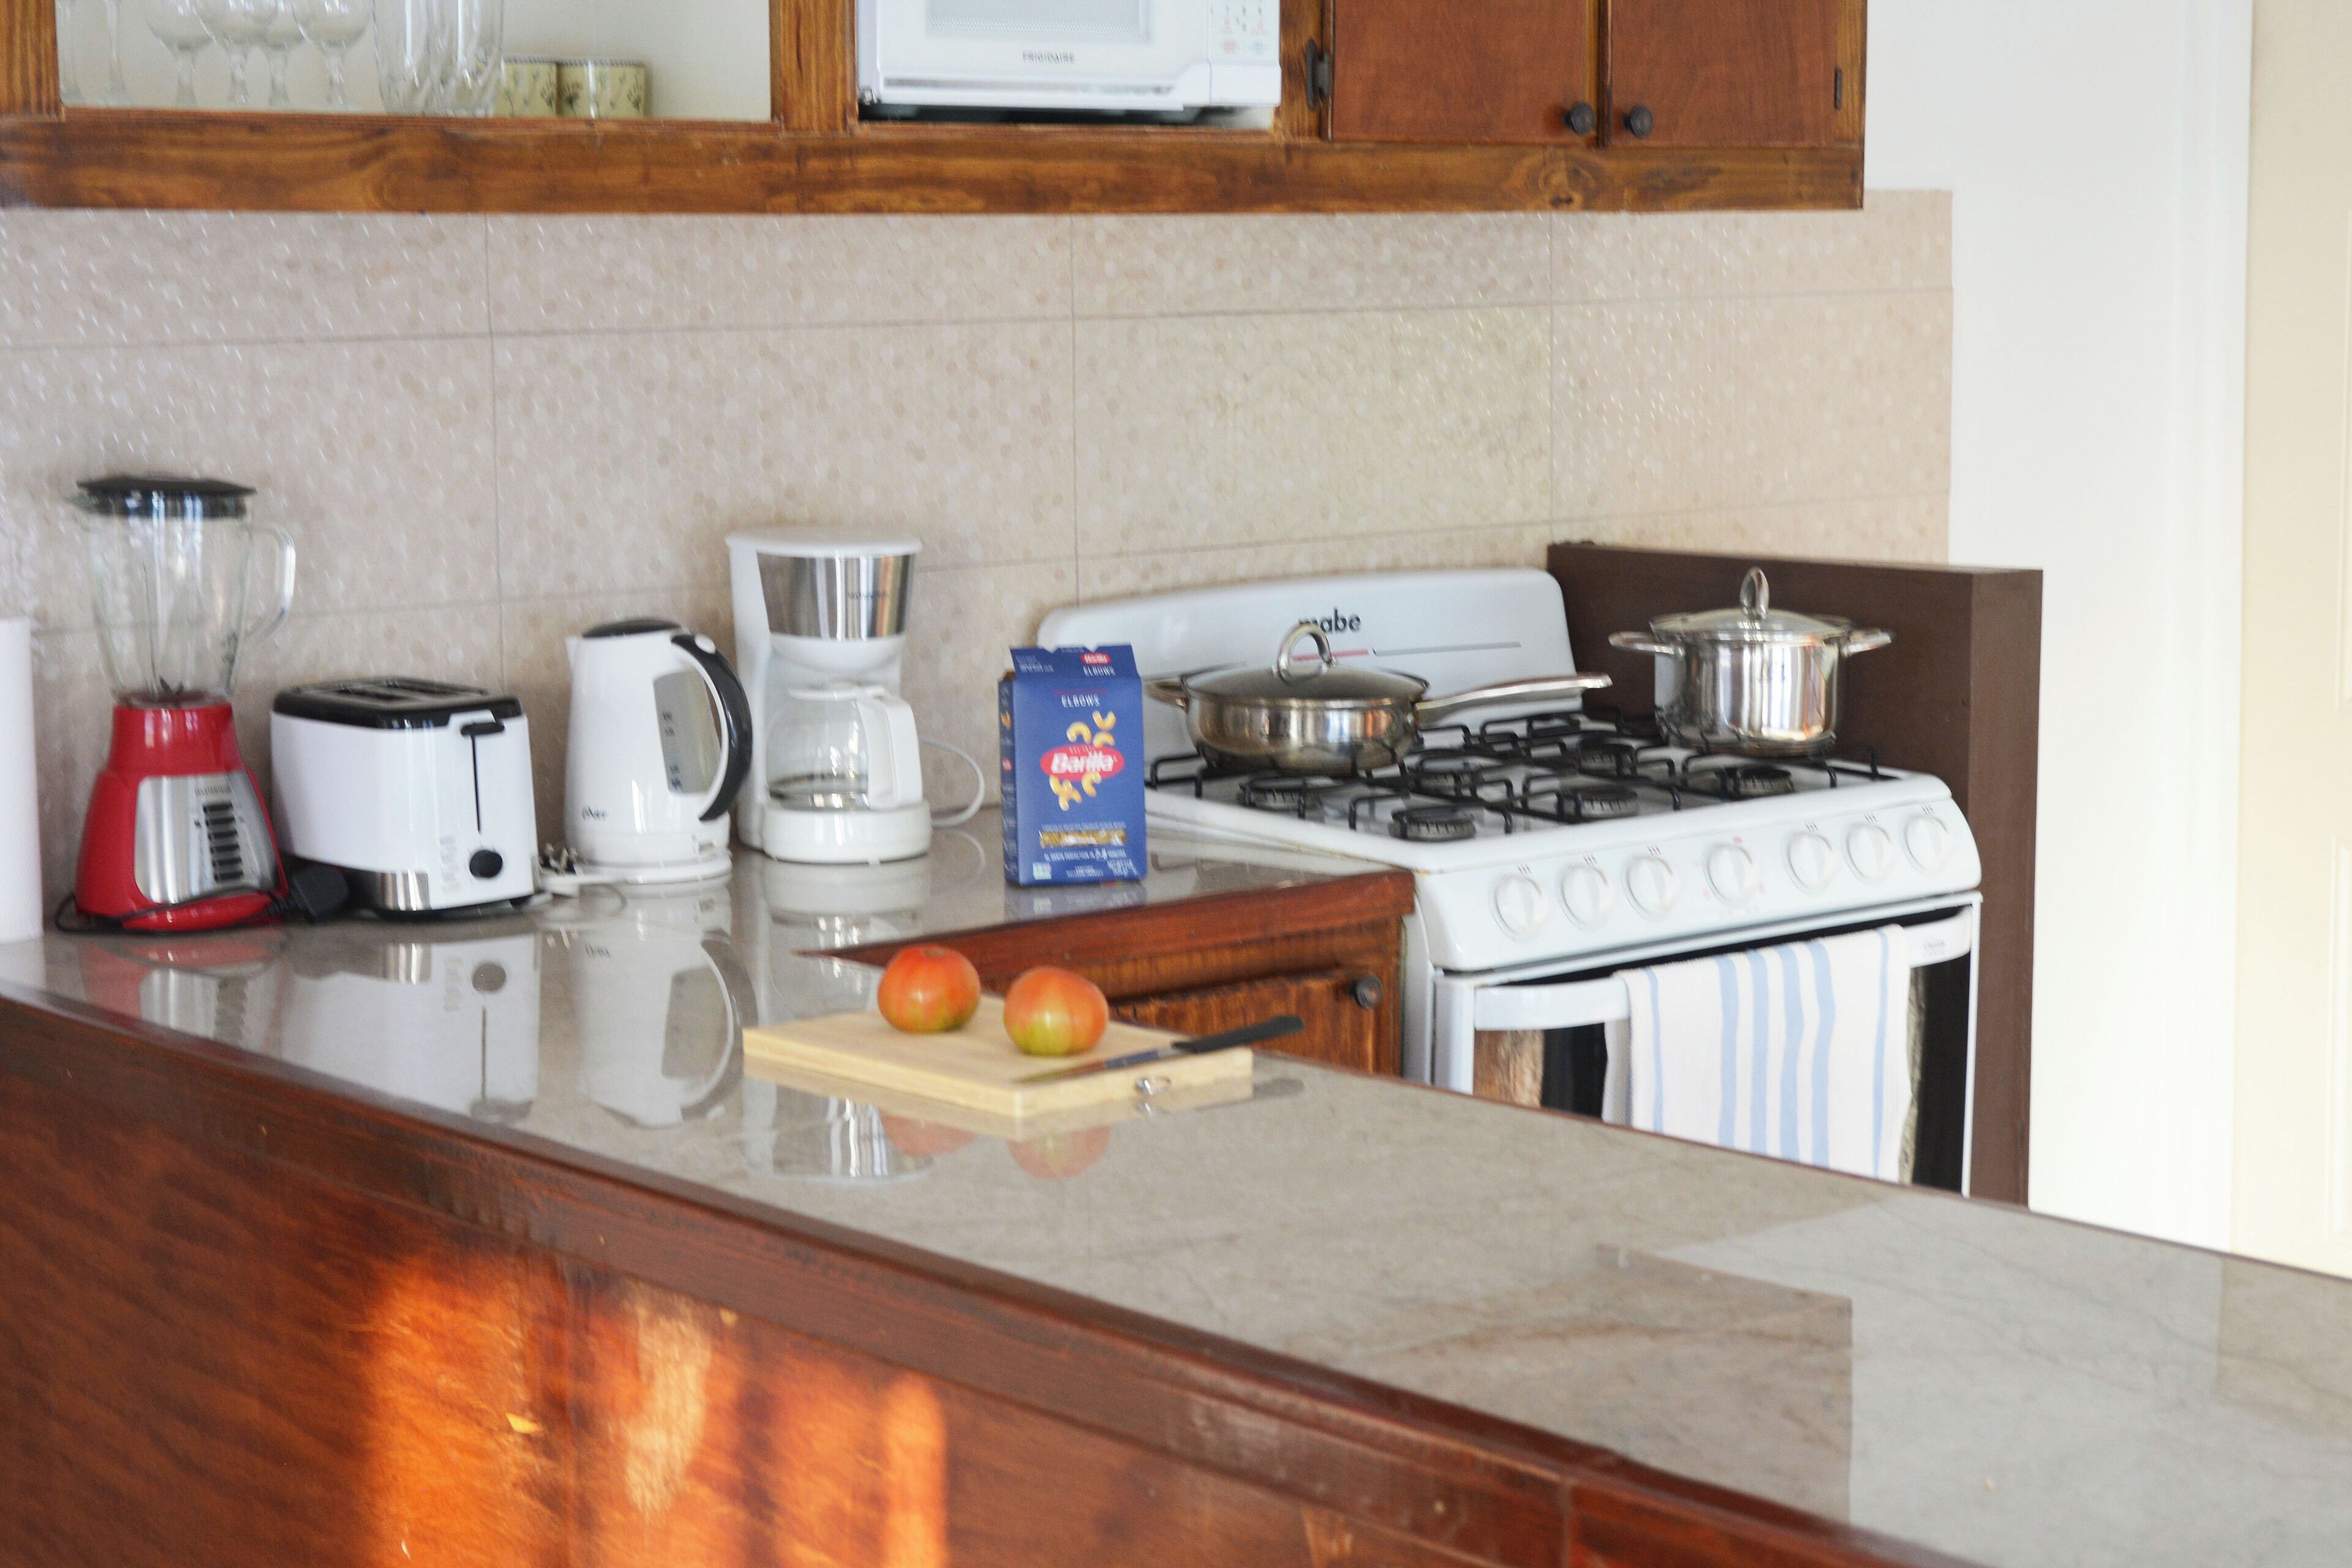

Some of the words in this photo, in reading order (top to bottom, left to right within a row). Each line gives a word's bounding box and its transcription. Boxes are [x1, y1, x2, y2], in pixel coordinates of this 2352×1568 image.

[1022, 51, 1074, 64] FRIGIDAIRE
[1083, 666, 1115, 676] ELBOWS
[1061, 694, 1101, 707] ELBOWS
[1050, 750, 1114, 774] Barilla
